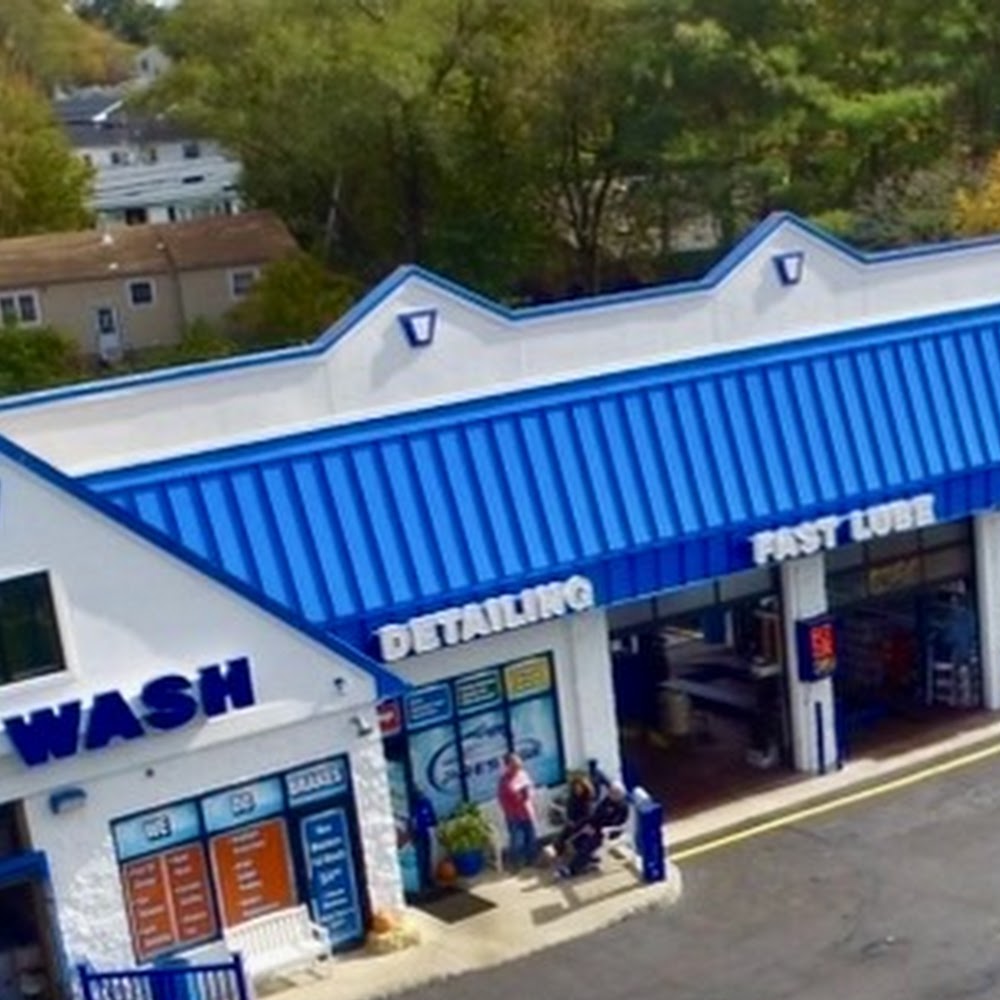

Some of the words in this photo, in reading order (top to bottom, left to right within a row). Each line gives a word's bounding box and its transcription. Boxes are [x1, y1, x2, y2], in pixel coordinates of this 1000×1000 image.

[750, 514, 842, 565] FAST
[849, 493, 936, 542] LUBE
[374, 575, 594, 662] DETAILING
[3, 657, 255, 767] WASH
